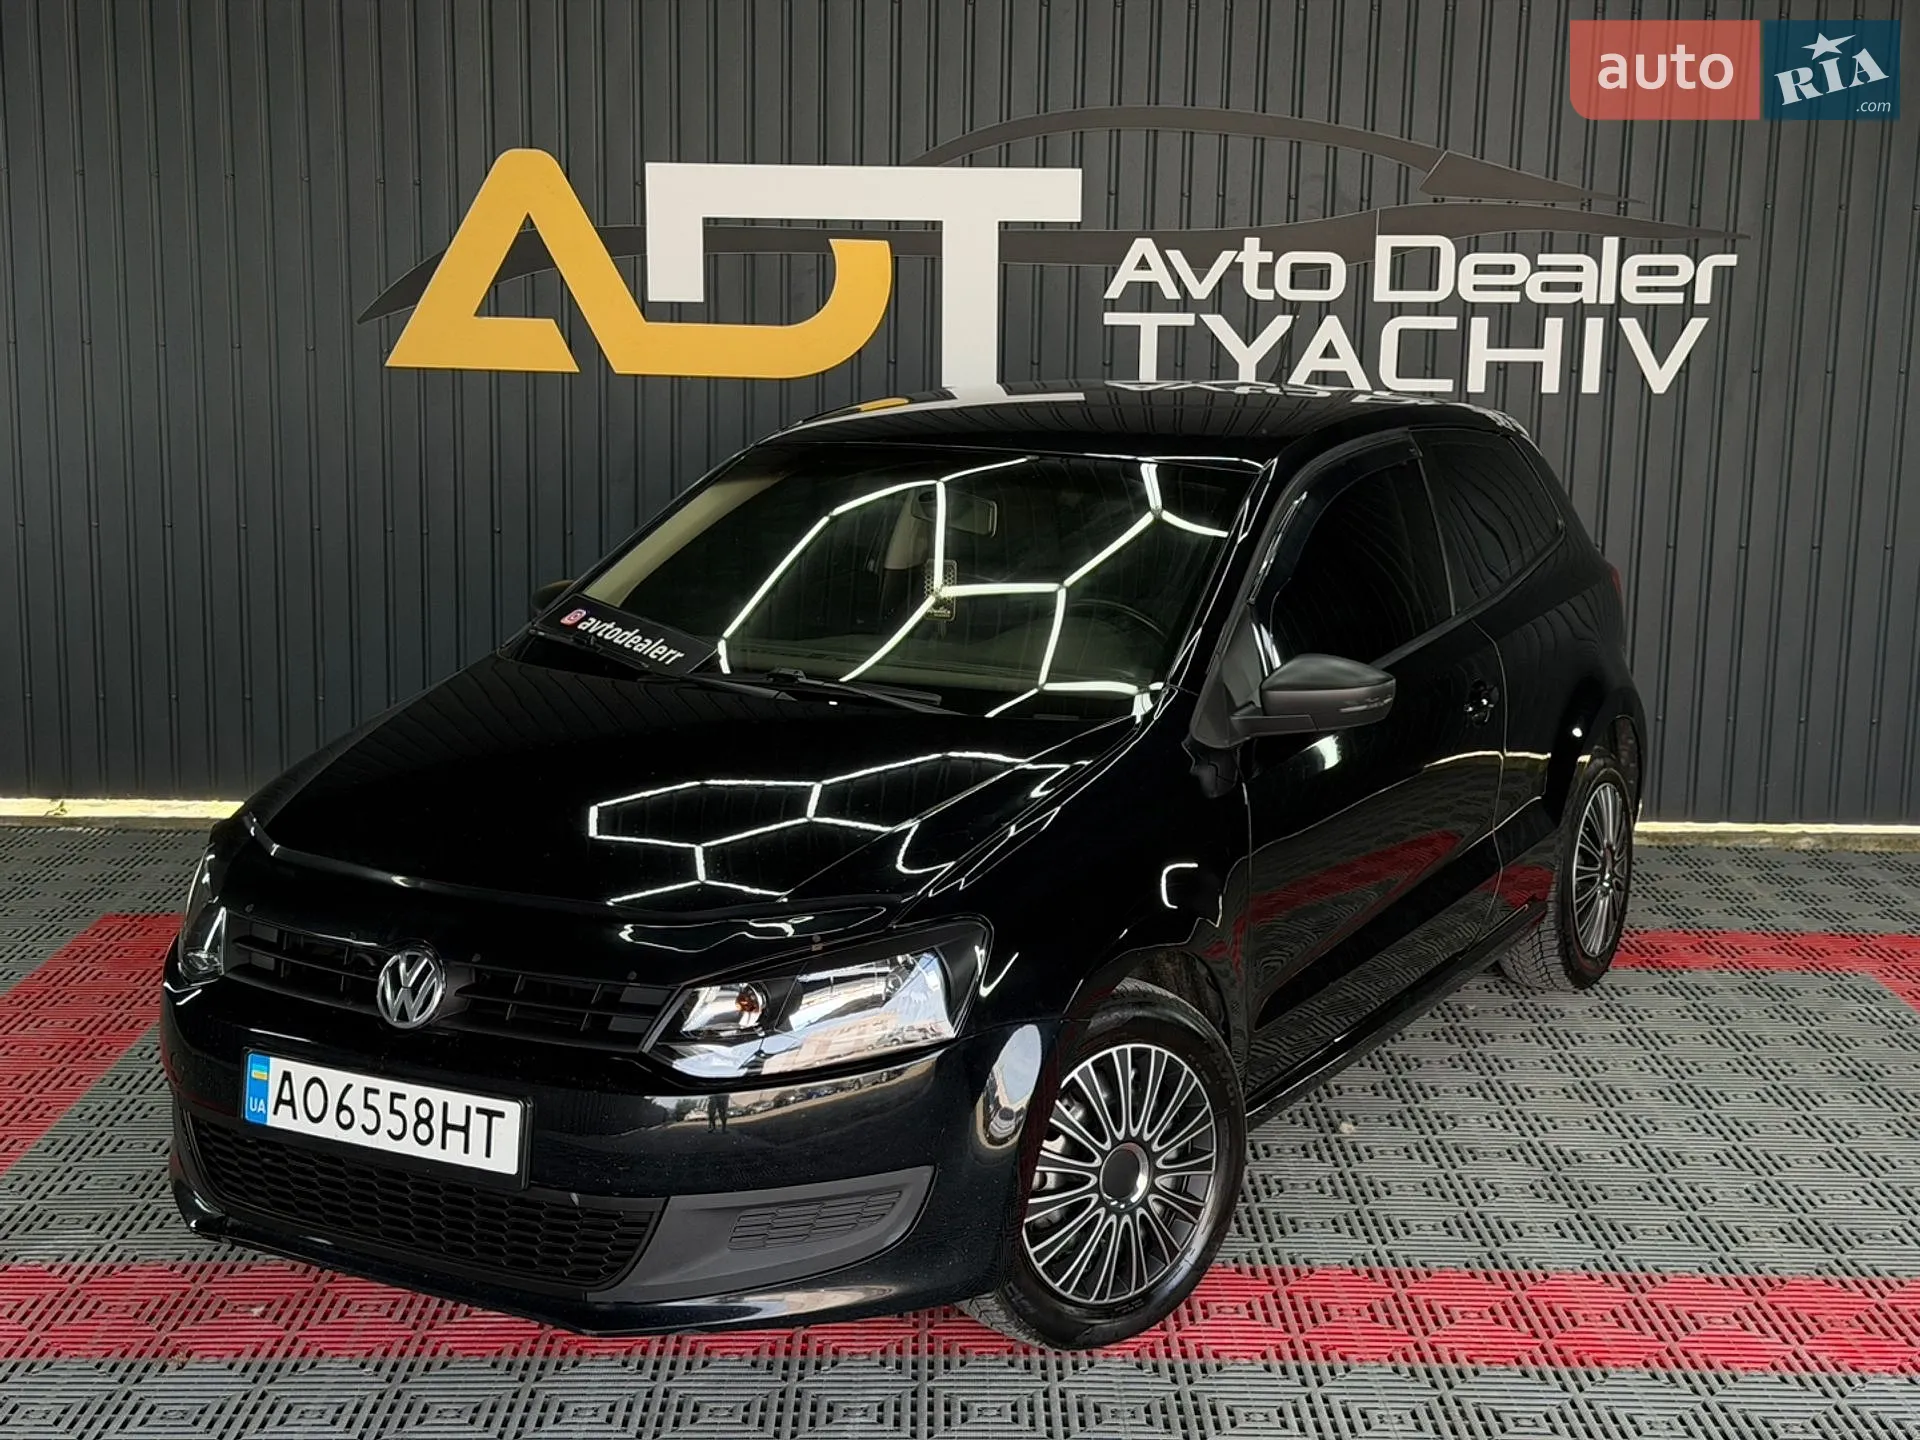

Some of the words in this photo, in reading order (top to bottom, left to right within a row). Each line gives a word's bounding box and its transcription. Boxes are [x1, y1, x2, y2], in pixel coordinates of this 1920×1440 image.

[385, 148, 1082, 390] ADT
[1103, 236, 1347, 301] Avto
[1373, 234, 1738, 304] Dealer
[1102, 311, 1710, 394] TYACHIV
[577, 613, 686, 667] avtodealerr
[249, 1096, 267, 1114] UA
[272, 1069, 506, 1159] AO6558HT
